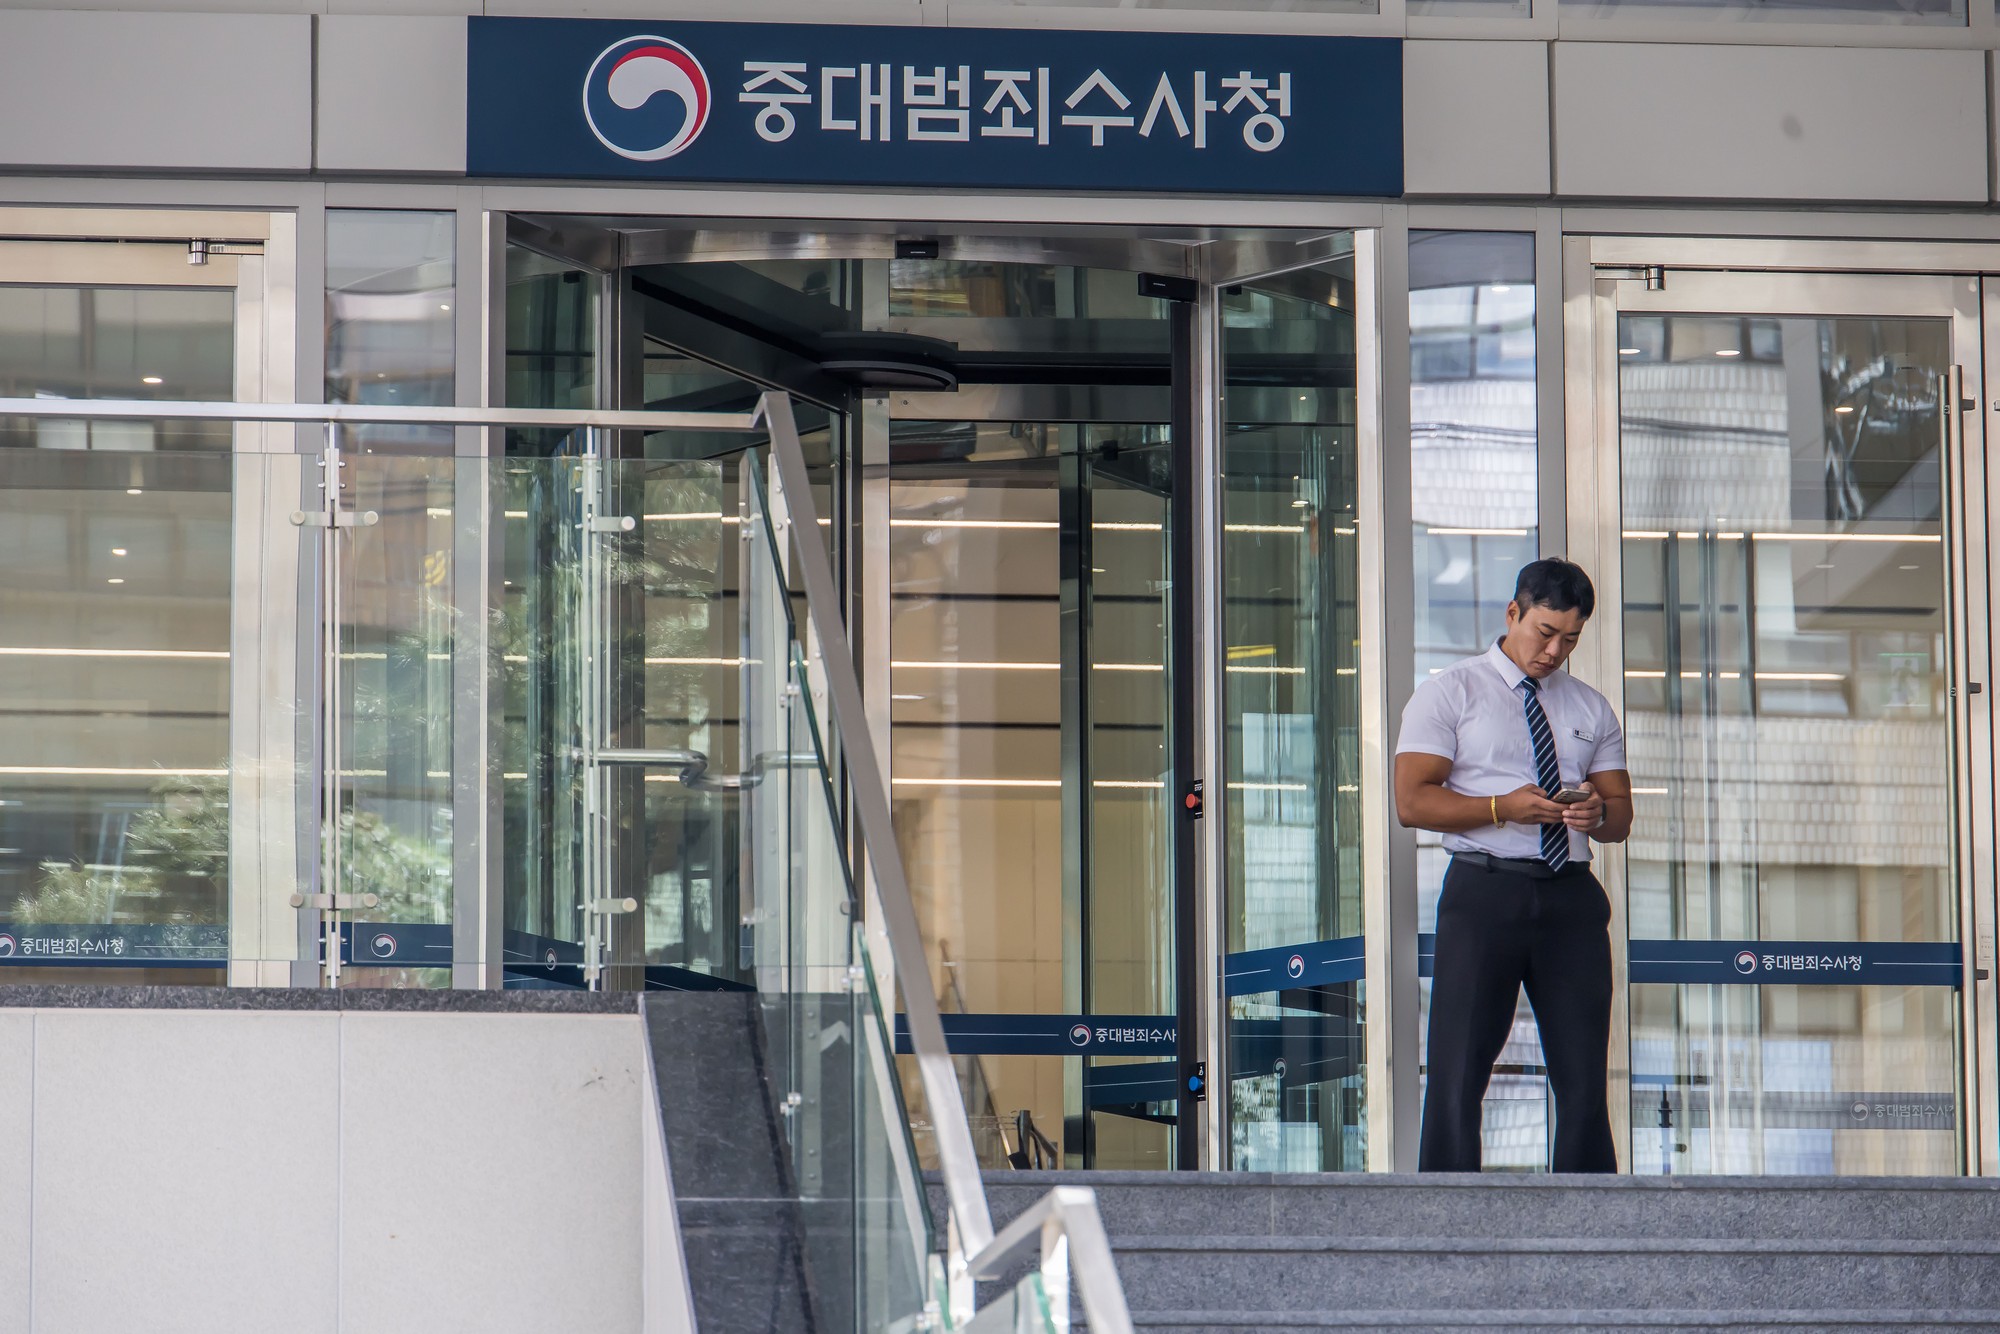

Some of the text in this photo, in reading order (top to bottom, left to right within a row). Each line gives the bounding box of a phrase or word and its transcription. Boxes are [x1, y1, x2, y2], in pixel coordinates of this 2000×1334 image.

[738, 61, 1292, 153] 중대범죄수사청
[20, 937, 124, 955] 중대범죄수사청
[1761, 955, 1862, 971] 중대범죄수사청
